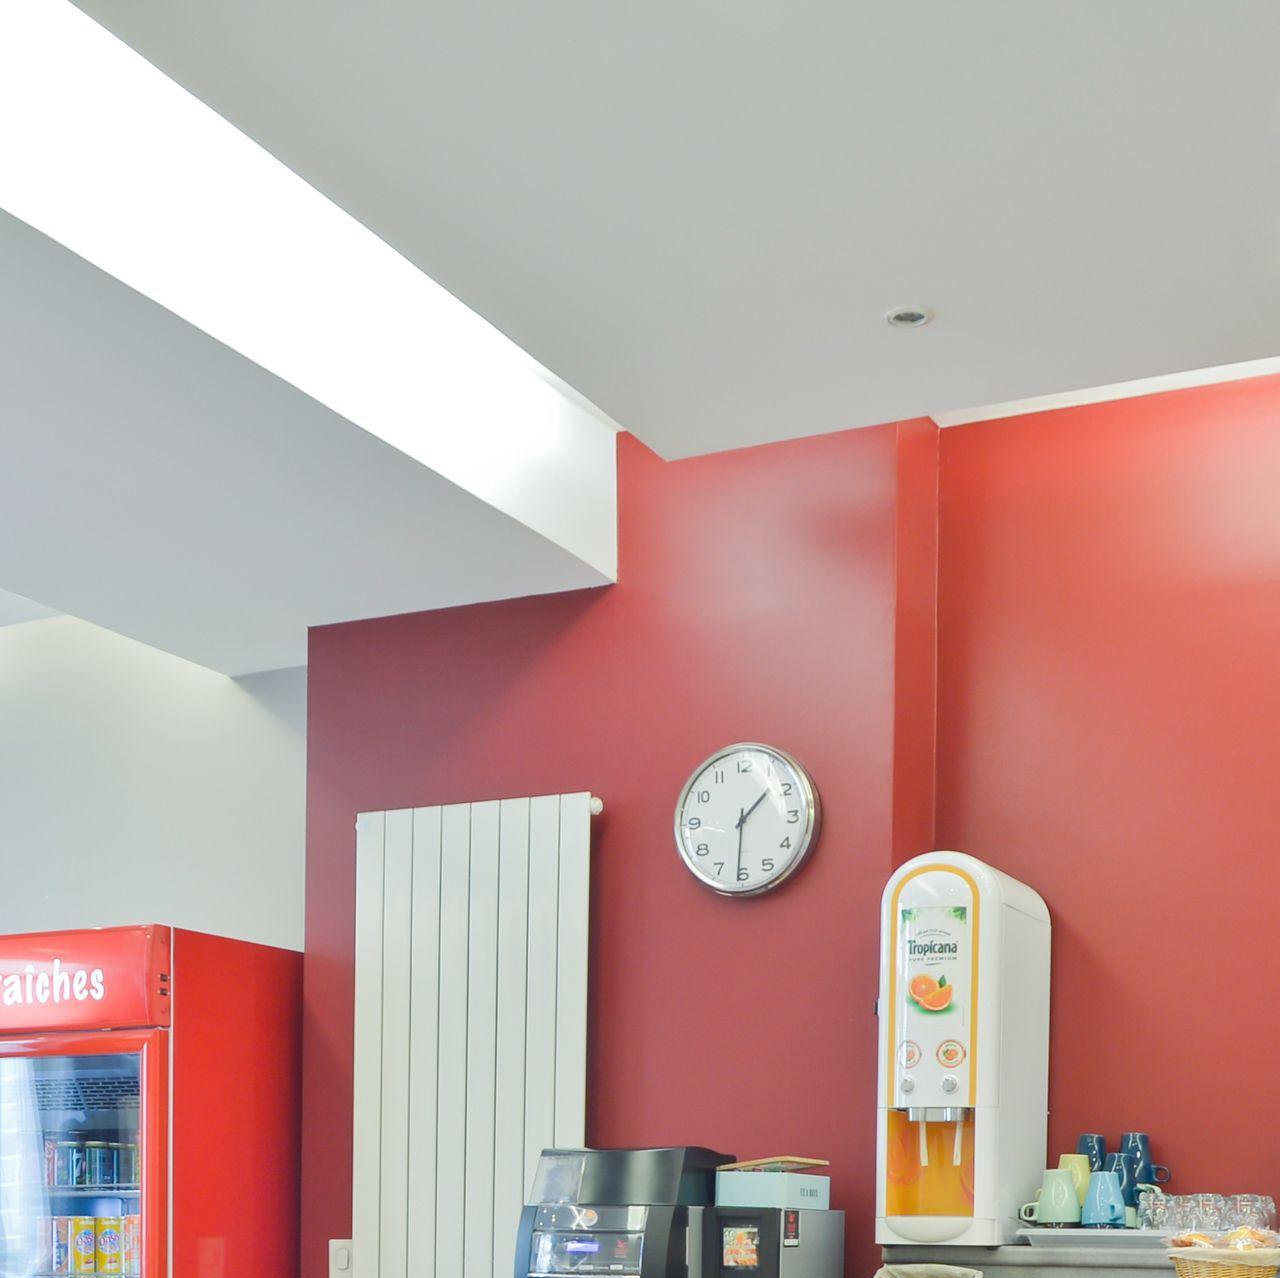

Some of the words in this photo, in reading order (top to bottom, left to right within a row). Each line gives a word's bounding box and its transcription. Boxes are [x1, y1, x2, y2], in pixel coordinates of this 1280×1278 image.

[737, 761, 752, 773] 12
[715, 770, 724, 784] 11
[781, 783, 792, 796] 2
[697, 790, 710, 803] 10
[688, 817, 701, 830] 9
[787, 810, 799, 824] 3
[696, 843, 709, 856] 8
[779, 836, 791, 850] 4
[713, 862, 724, 875] 7
[762, 858, 774, 871] 5
[737, 867, 749, 881] 6
[908, 940, 958, 956] Tropicana
